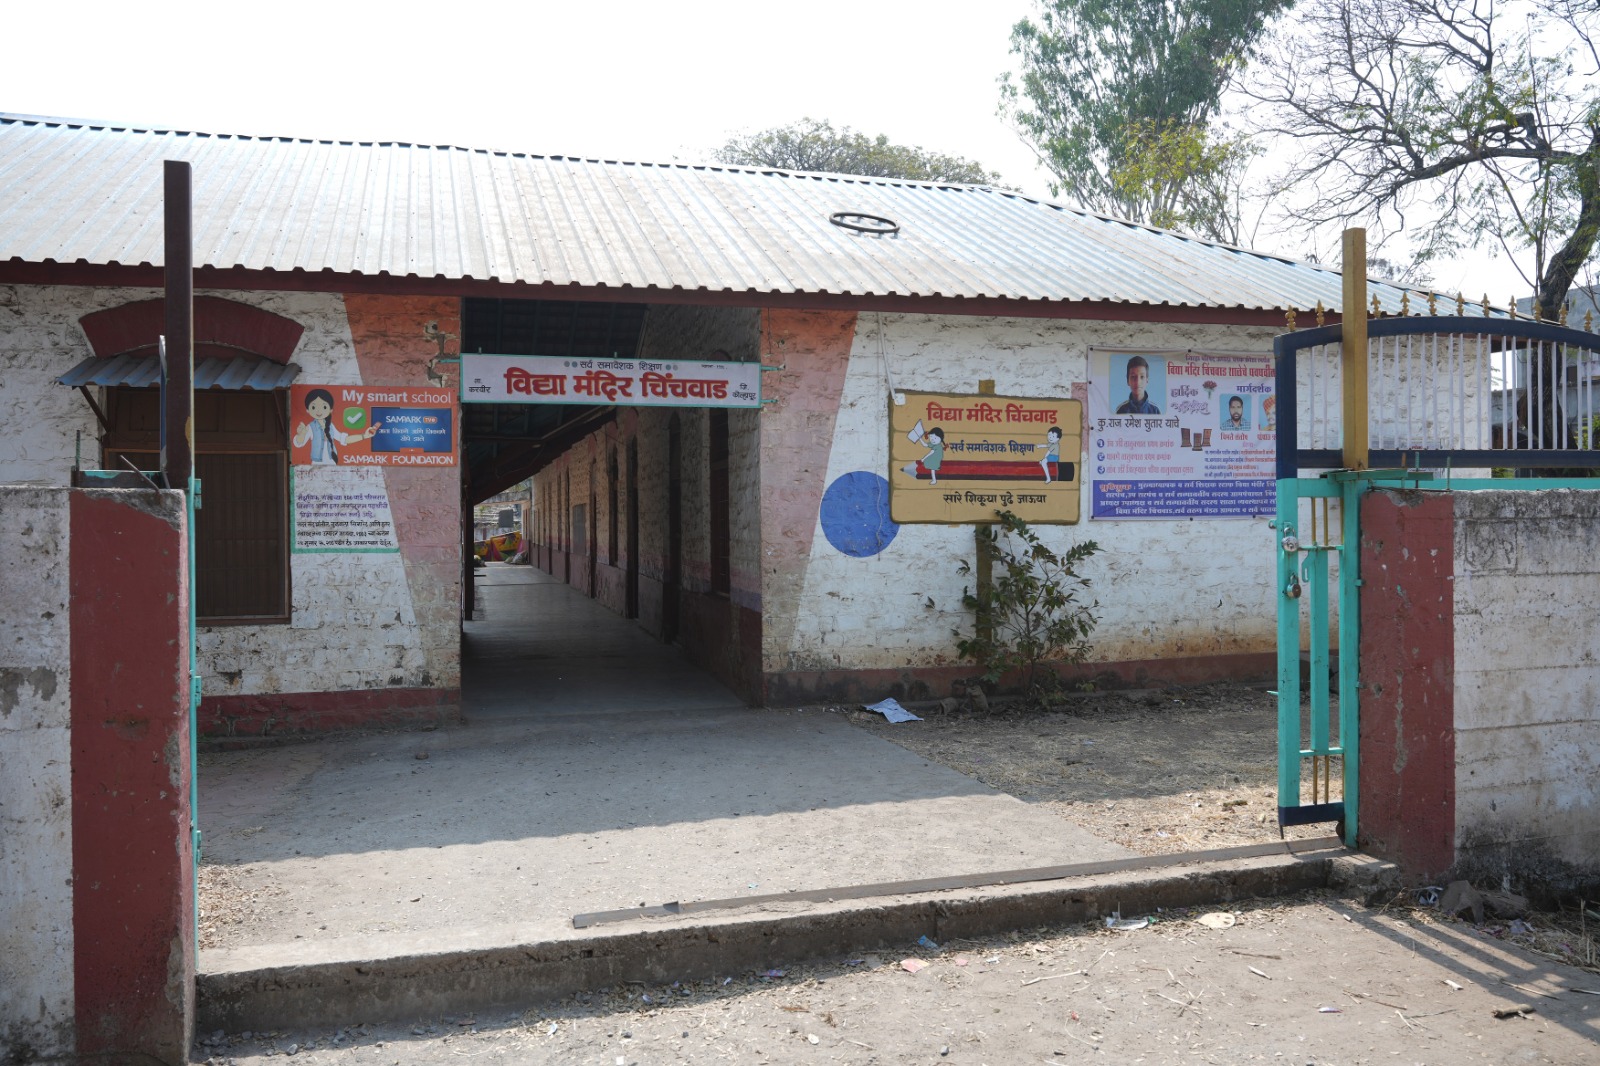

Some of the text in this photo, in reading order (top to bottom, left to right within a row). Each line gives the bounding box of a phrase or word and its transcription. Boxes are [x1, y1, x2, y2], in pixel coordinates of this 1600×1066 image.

[580, 360, 662, 371] सर्व समावेशक शिक्षण
[1185, 362, 1200, 376] मंदिर
[1202, 362, 1227, 376] चिंचवाड
[469, 385, 491, 393] करवीर
[504, 366, 728, 401] विद्या मंदिर चिंचवाड
[1236, 383, 1271, 393] मार्गदर्शक
[343, 390, 451, 404] My smart school
[926, 401, 1057, 424] विद्या मंदिर चिंचवाड
[1098, 416, 1179, 432] कु.राज रमेश सुतार याचे
[949, 440, 1035, 456] सर्व समावेशक शिक्षण
[343, 455, 453, 464] SAMPARK FOUNDATION
[943, 491, 1046, 506] सारे शिकूया पुढे जाऊया
